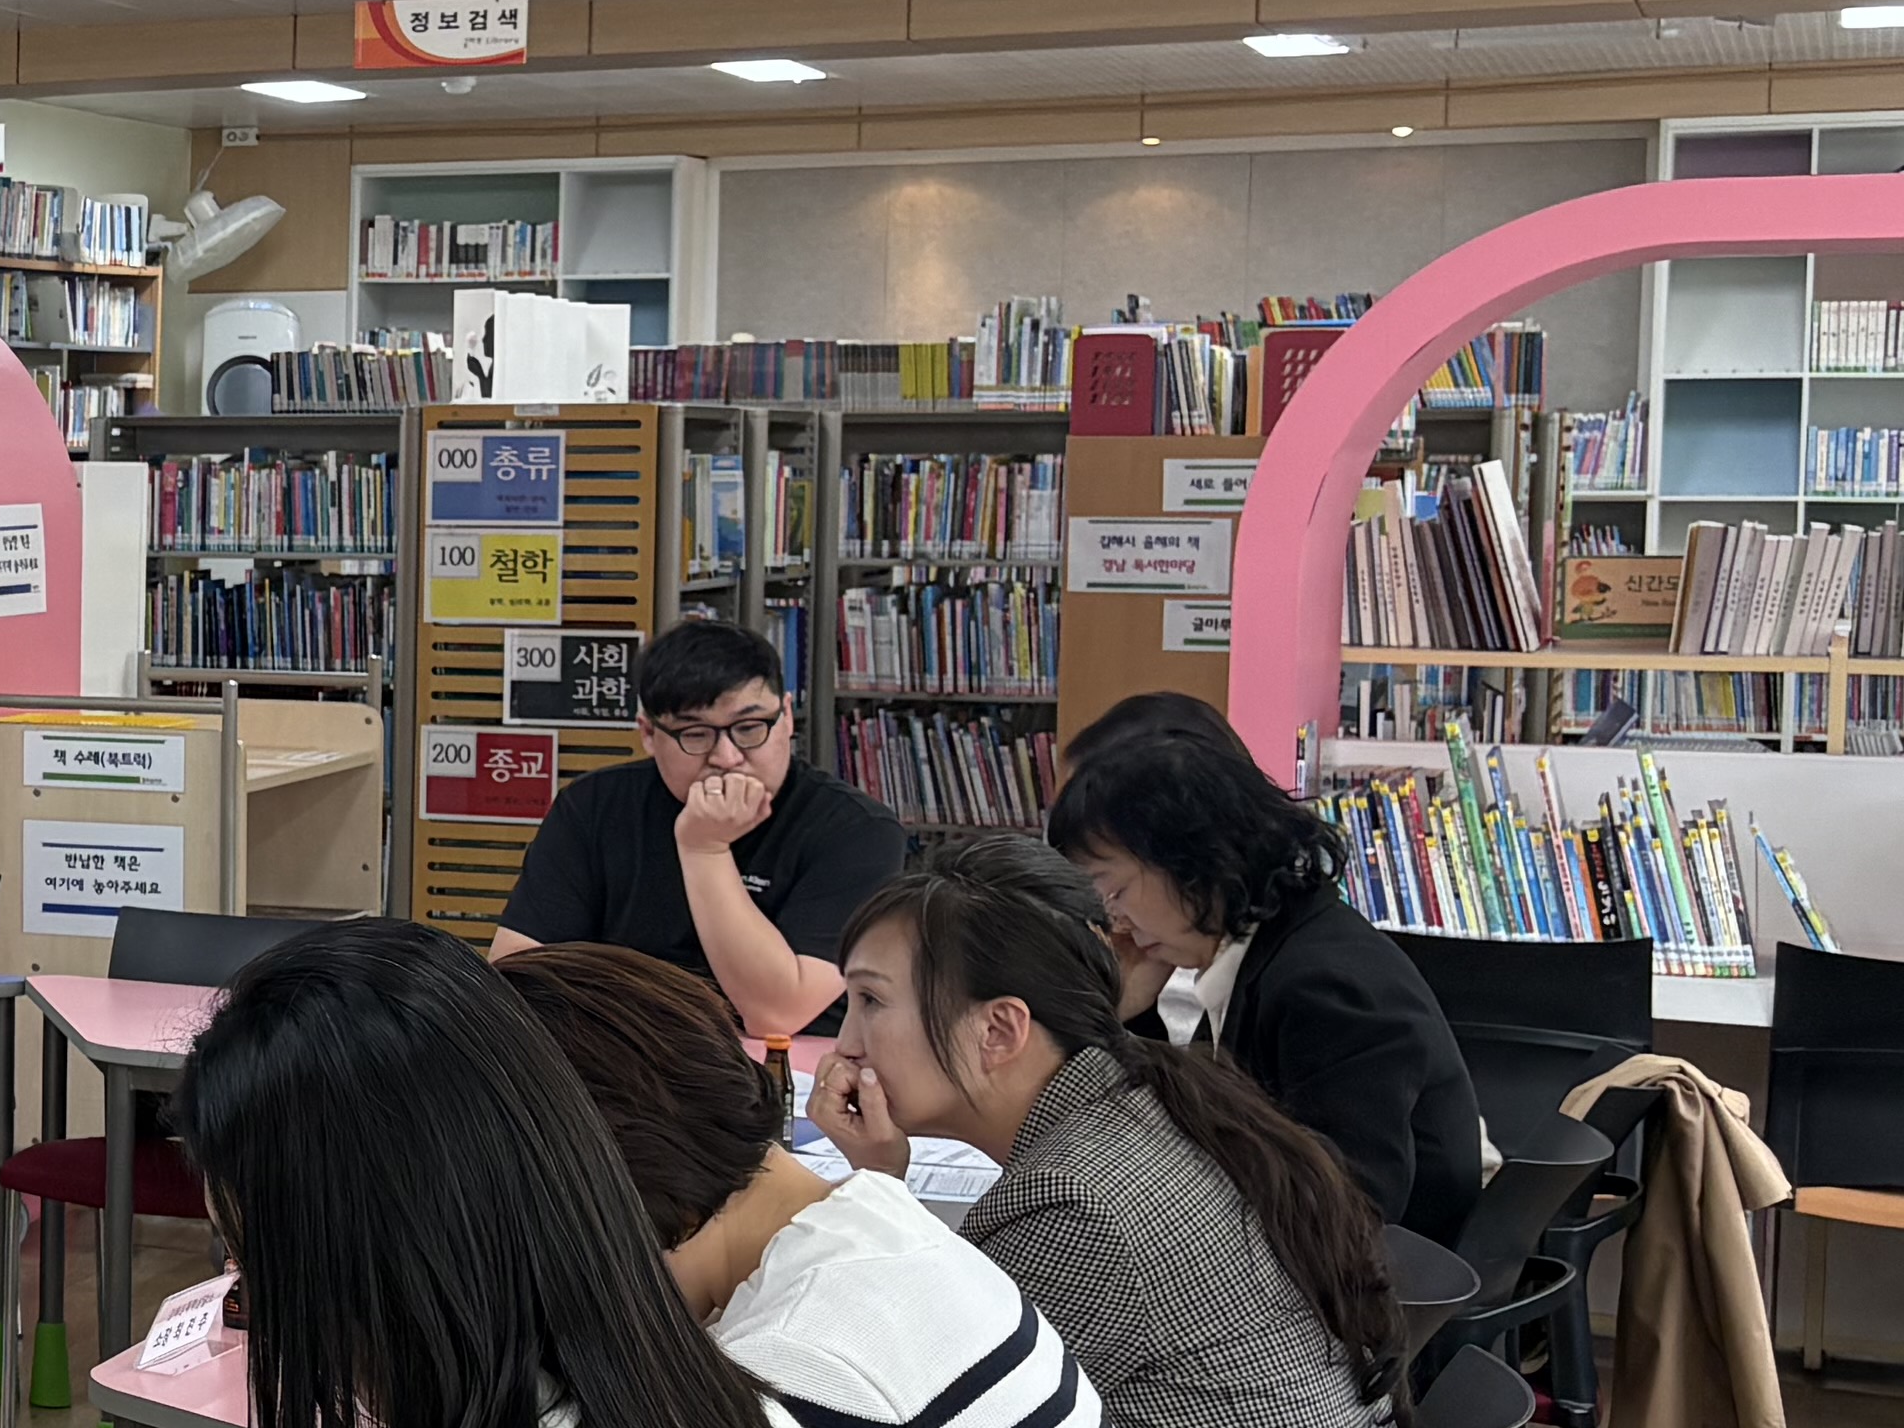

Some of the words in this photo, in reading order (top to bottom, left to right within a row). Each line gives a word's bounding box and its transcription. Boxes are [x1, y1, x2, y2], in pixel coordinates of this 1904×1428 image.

[438, 448, 478, 469] 000
[489, 446, 557, 481] 총류
[1187, 536, 1200, 551] 책
[439, 546, 476, 566] 100
[490, 549, 554, 584] 철학
[516, 647, 556, 668] 300
[573, 642, 628, 674] 사회
[572, 676, 631, 707] 과학
[53, 749, 67, 765] 책
[432, 743, 471, 764] 200
[484, 748, 549, 783] 종교
[65, 853, 105, 870] 반납한
[113, 855, 141, 872] 책은
[44, 877, 84, 891] 여기에
[92, 878, 162, 895] 놓아주세요
